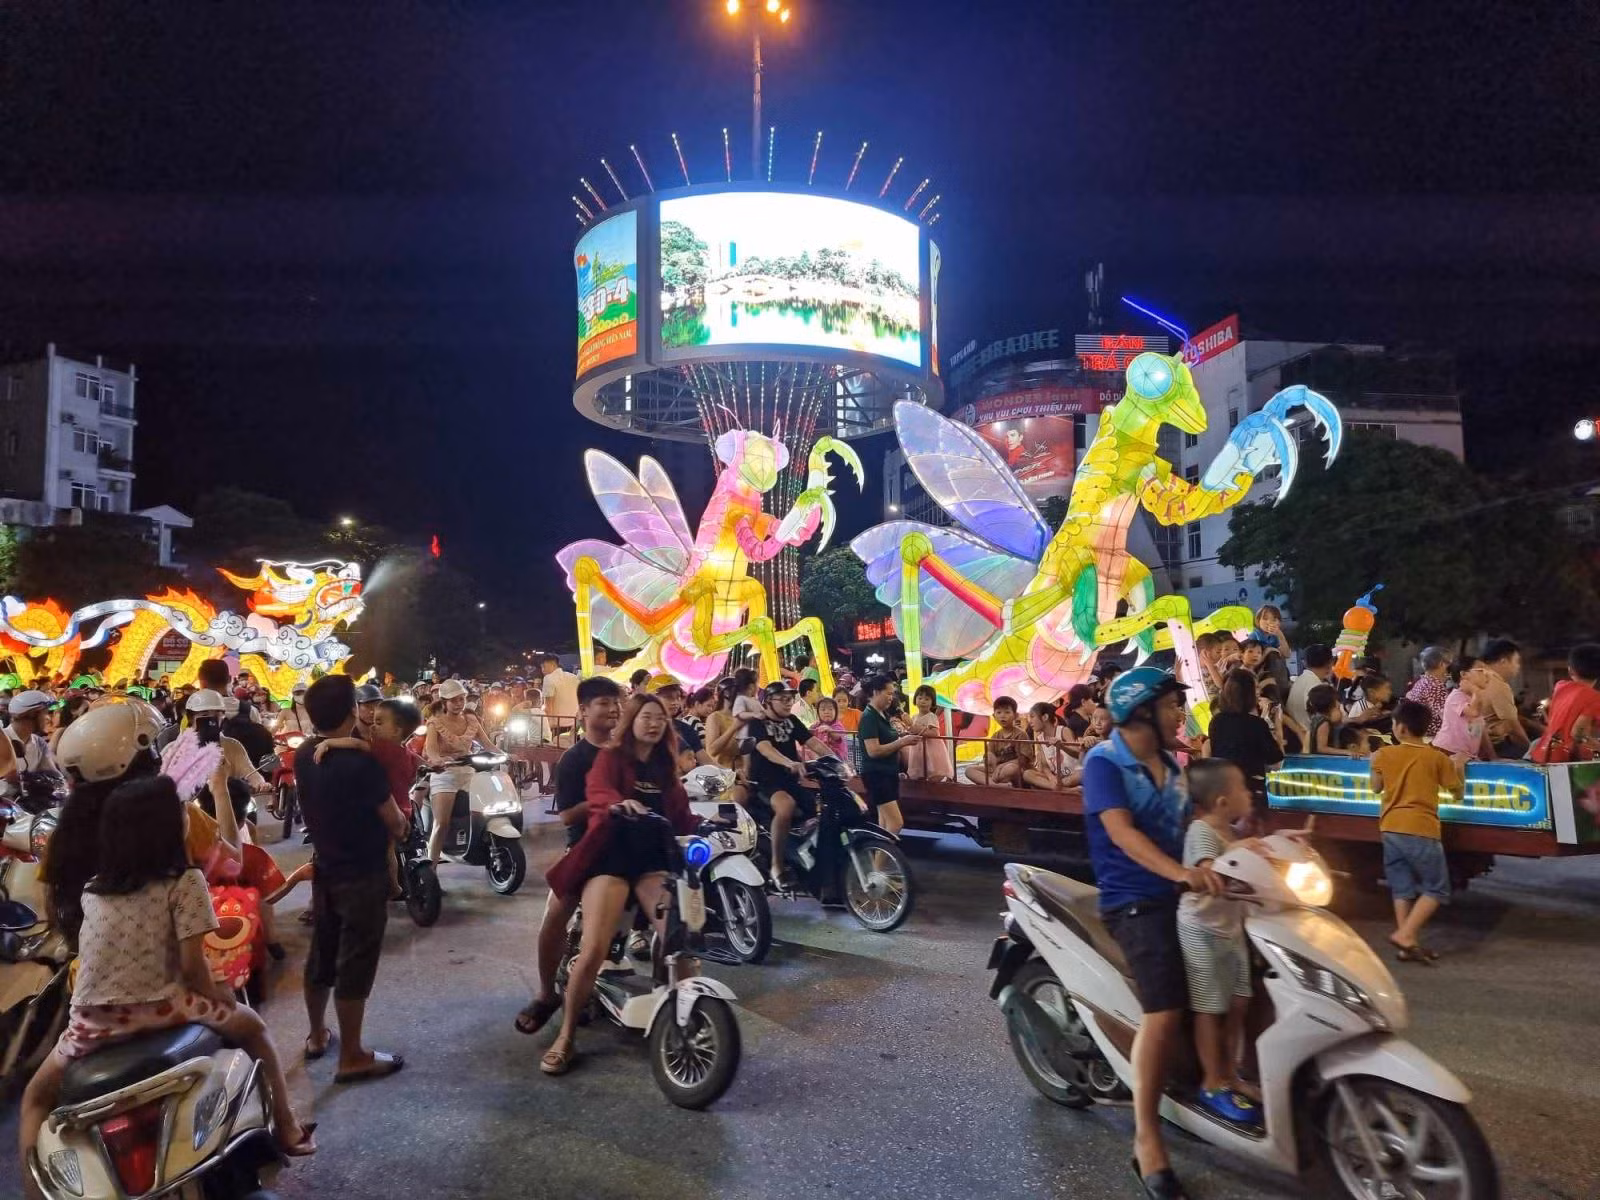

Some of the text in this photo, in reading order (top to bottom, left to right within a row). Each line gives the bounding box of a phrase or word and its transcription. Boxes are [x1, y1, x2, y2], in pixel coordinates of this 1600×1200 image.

[1184, 326, 1233, 361] TOSHIBA
[996, 408, 1009, 418] VUI
[1065, 403, 1083, 412] NHI
